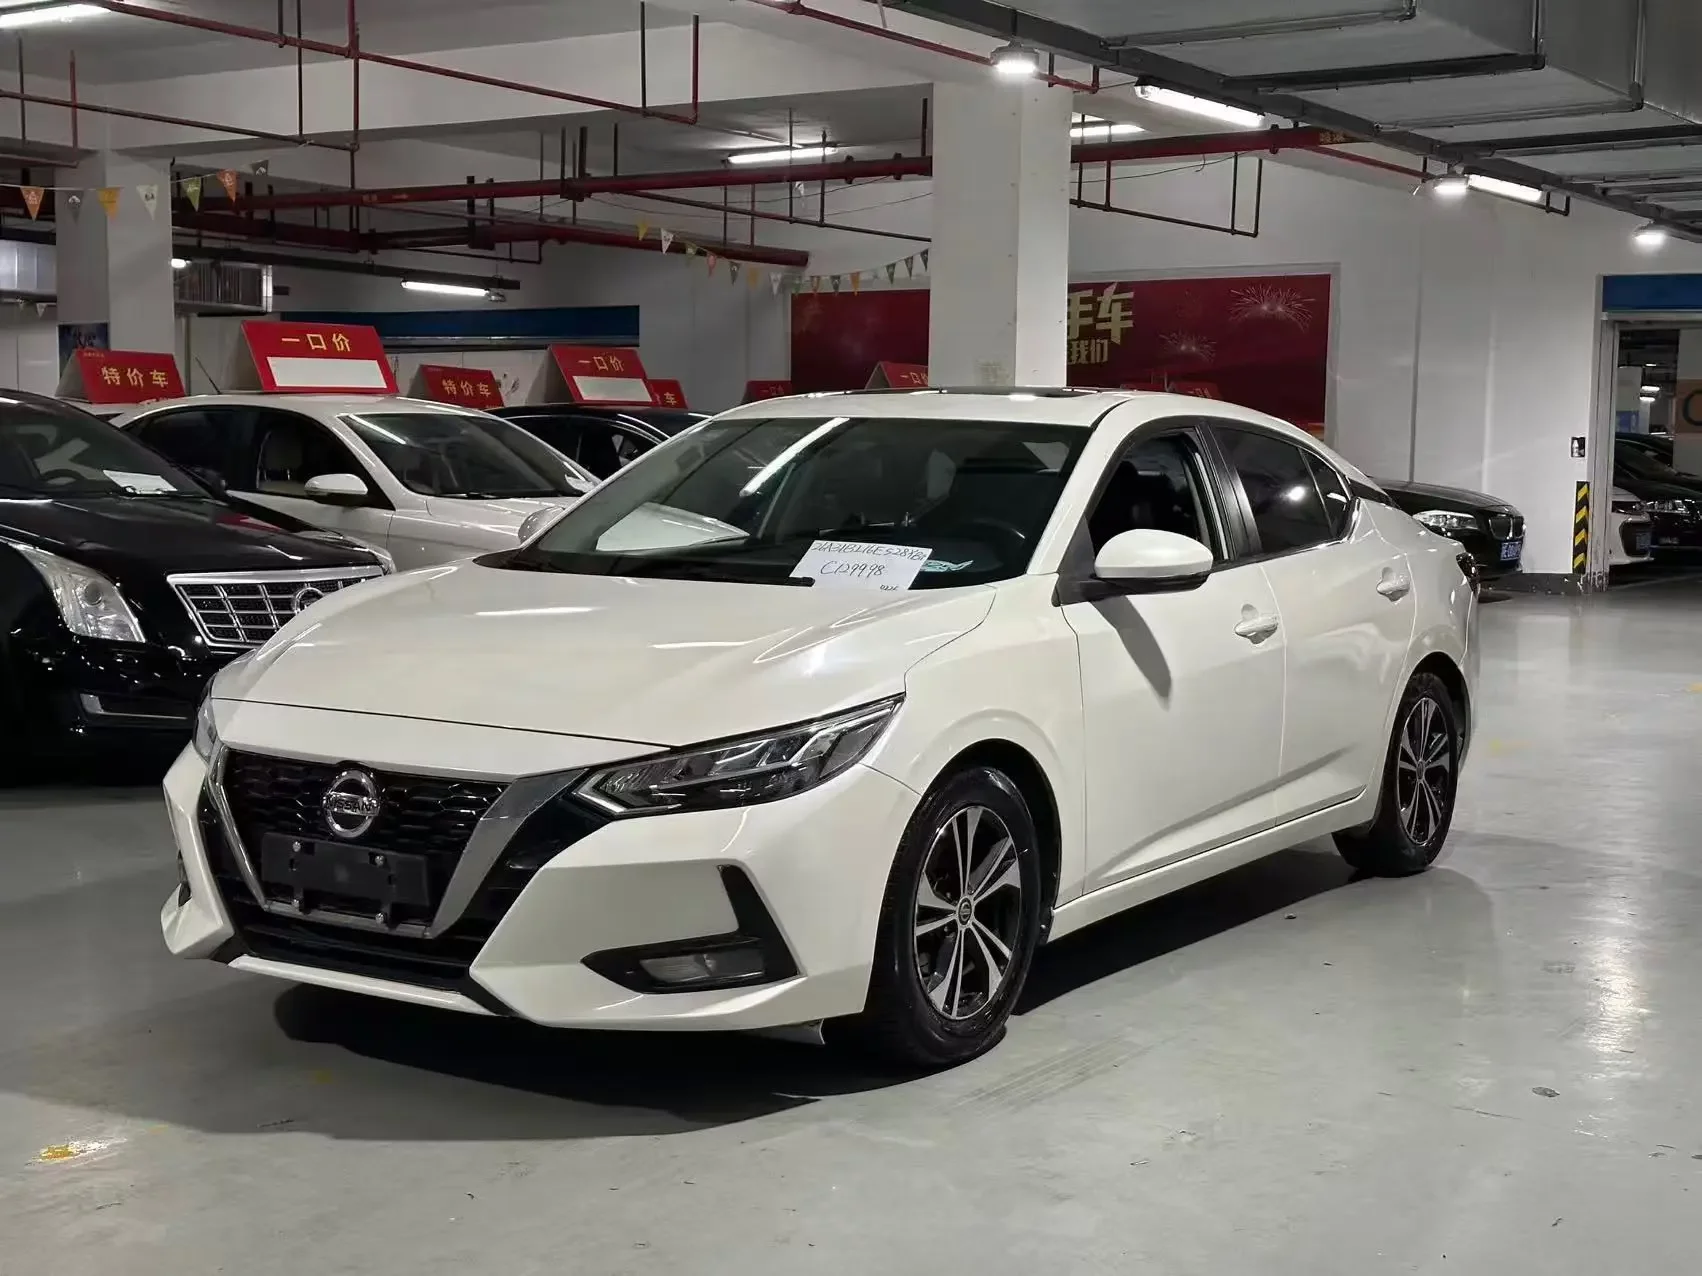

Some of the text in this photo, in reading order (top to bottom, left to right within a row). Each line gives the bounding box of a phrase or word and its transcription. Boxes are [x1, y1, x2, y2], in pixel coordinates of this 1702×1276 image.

[281, 333, 351, 352] 一口价
[578, 355, 625, 372] 一口价
[101, 366, 169, 388] 特价车
[442, 379, 492, 397] 特价车
